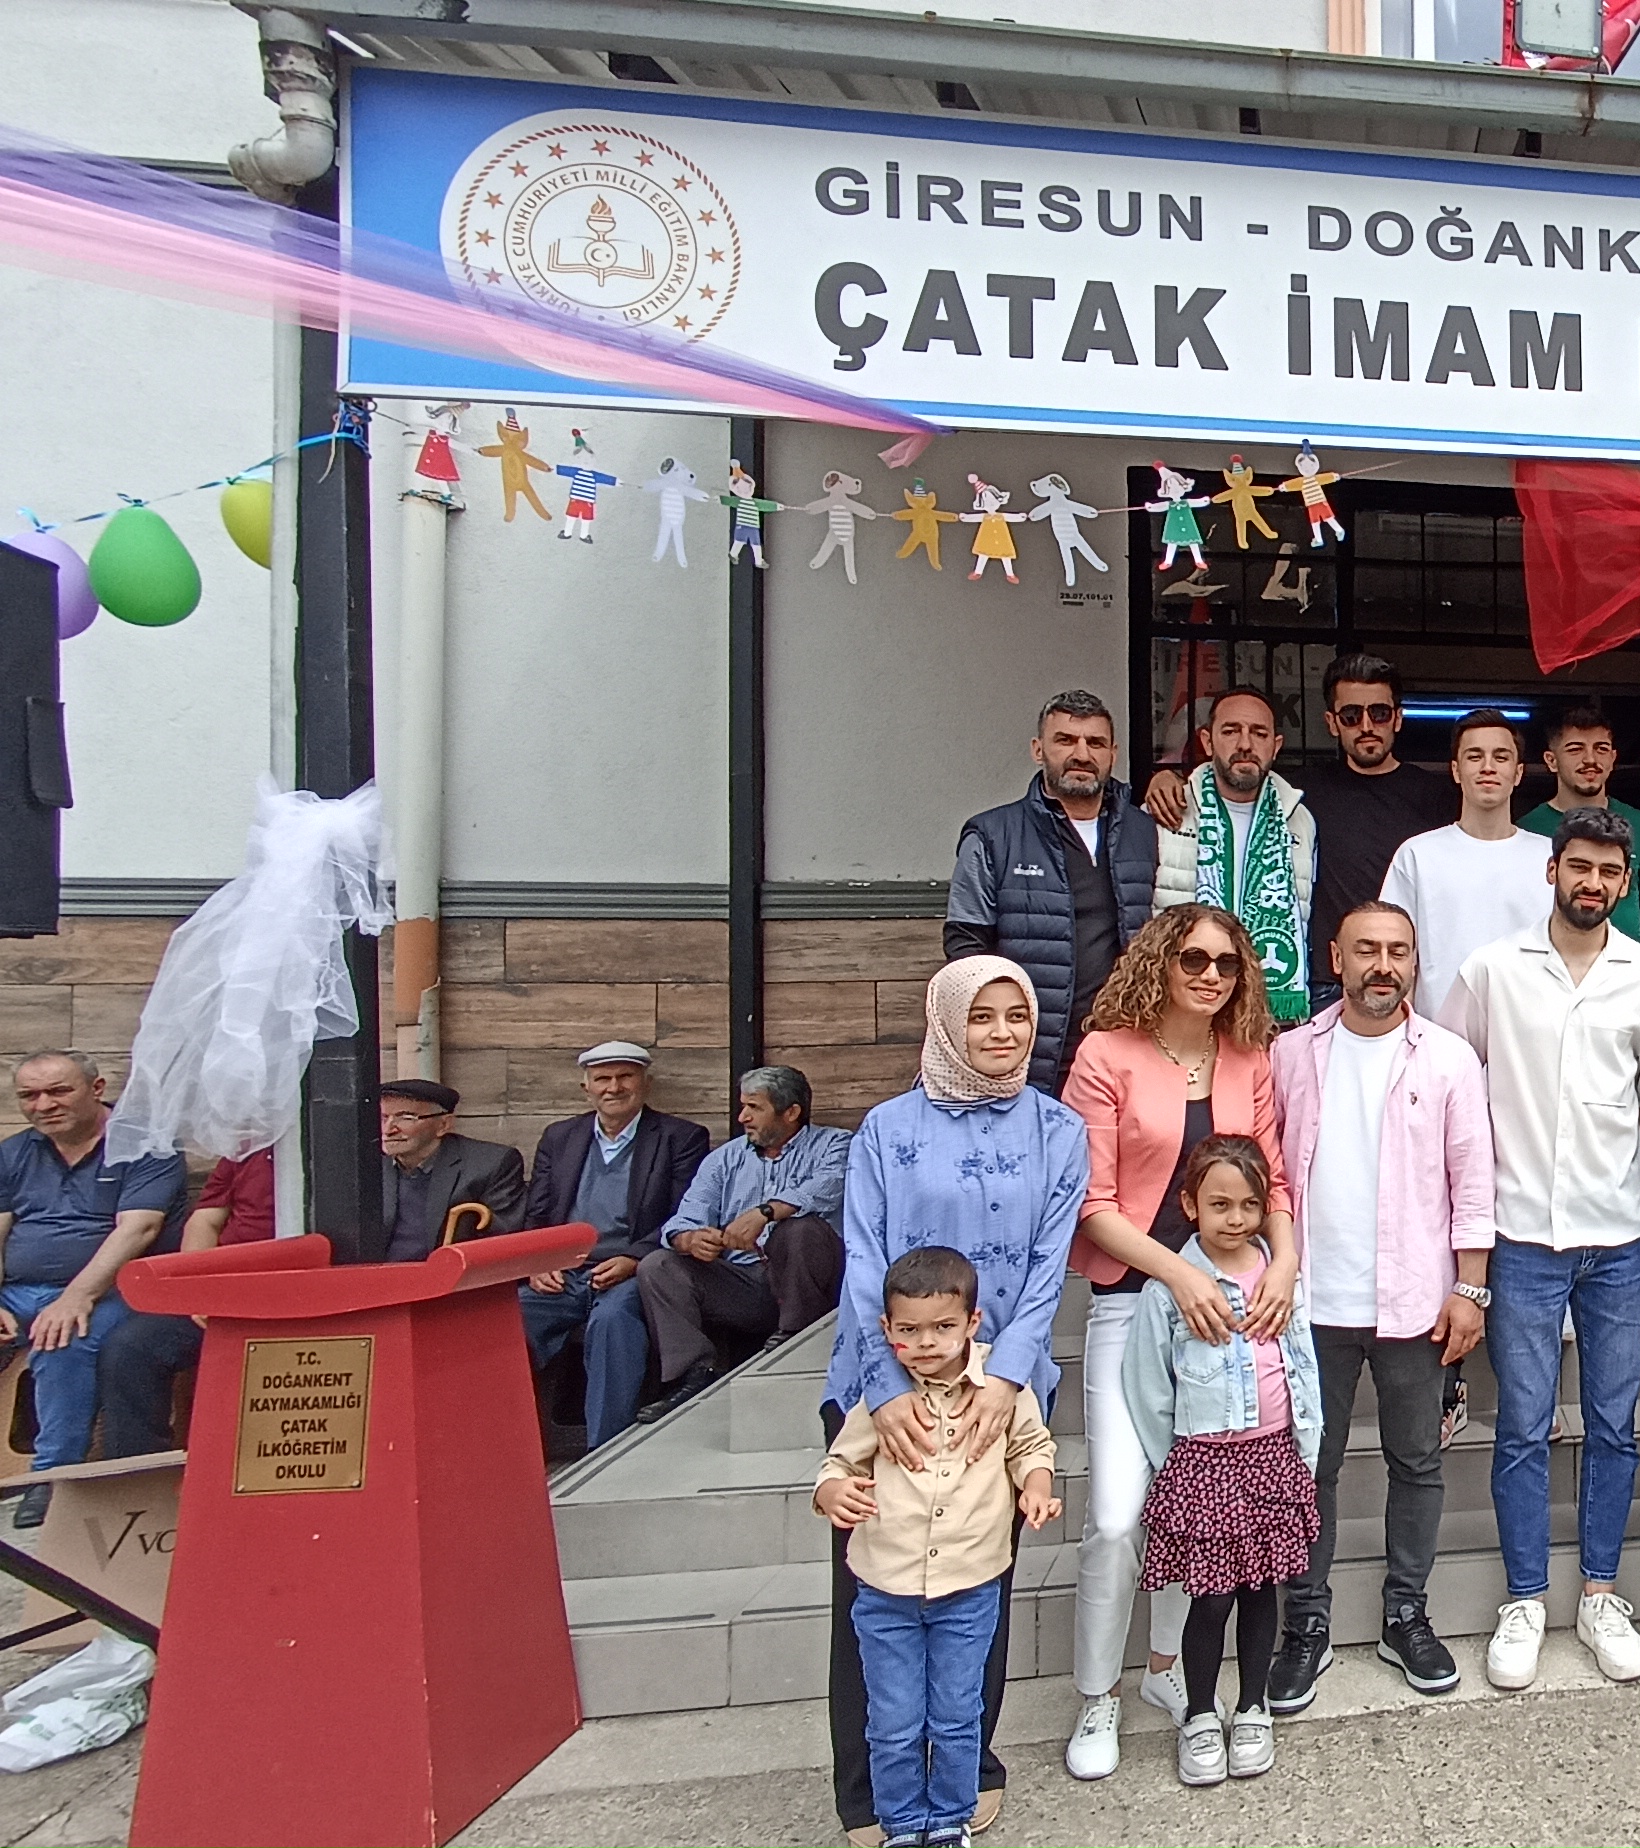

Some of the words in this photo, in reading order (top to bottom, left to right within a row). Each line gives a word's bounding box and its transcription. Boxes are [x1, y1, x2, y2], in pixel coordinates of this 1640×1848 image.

[595, 169, 648, 195] MİLLİ
[511, 167, 589, 255] CUMHURİYETİ
[814, 160, 1203, 242] GİRESUN
[1246, 223, 1269, 236] -
[650, 191, 689, 247] EĞİTİM
[621, 253, 690, 323] BAKANLIĞI
[814, 261, 1228, 372] ÇATAK
[1287, 273, 1583, 392] İMAM
[295, 1351, 321, 1366] T.C.
[262, 1371, 353, 1389] DOĞANKENT
[249, 1392, 361, 1412] KAYMAKAMLIĞI
[280, 1418, 328, 1437] ÇATAK
[256, 1437, 347, 1458] İLKÖĞRETİM
[275, 1463, 326, 1480] OKULU
